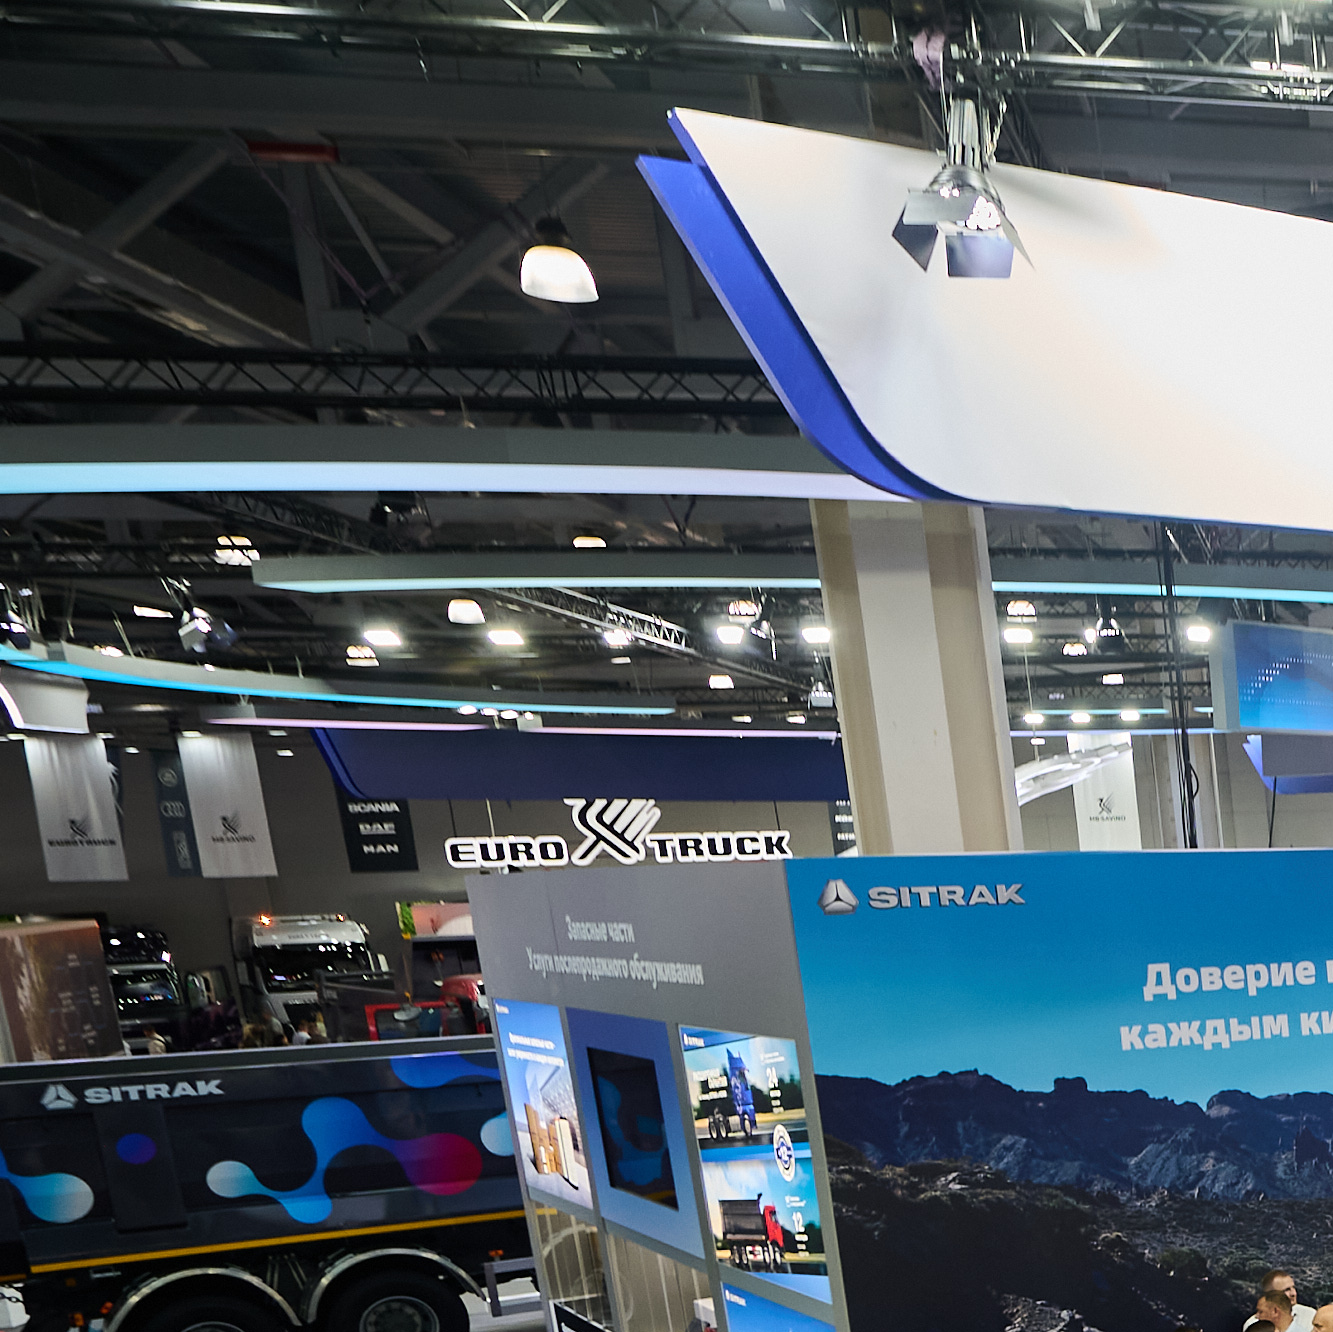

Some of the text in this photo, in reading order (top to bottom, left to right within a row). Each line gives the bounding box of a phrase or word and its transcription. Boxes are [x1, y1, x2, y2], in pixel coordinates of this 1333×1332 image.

[363, 844, 400, 855] MAN
[444, 829, 793, 869] EURO TRUCK
[867, 882, 1026, 910] SITRAK
[565, 914, 635, 943] Запасные части
[526, 946, 704, 989] Услуги послепродажного обслуживания
[1143, 960, 1316, 1002] Доверие
[1119, 1006, 1291, 1052] каждым
[84, 1079, 226, 1105] SITRAK
